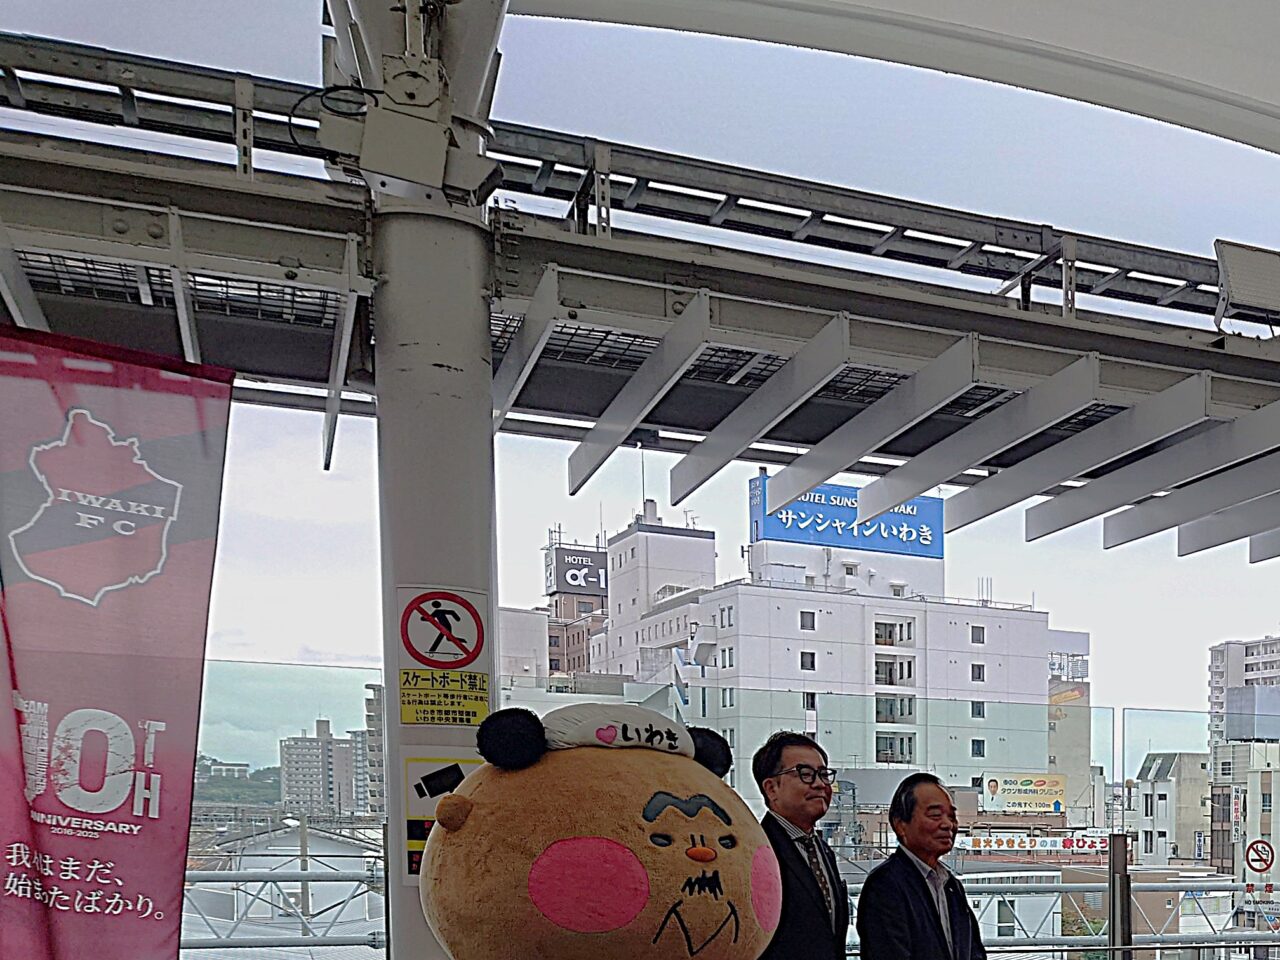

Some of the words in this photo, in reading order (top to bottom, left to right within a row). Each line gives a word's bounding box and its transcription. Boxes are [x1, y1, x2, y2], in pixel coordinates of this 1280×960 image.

[57, 488, 166, 518] IWAKI
[829, 495, 858, 508] SUNS
[777, 509, 933, 545] サンシャインいわき
[564, 555, 595, 566] HOTEL
[402, 671, 487, 691] スケートボード禁止
[622, 723, 679, 751] いわき
[50, 826, 101, 839] 2016-2025
